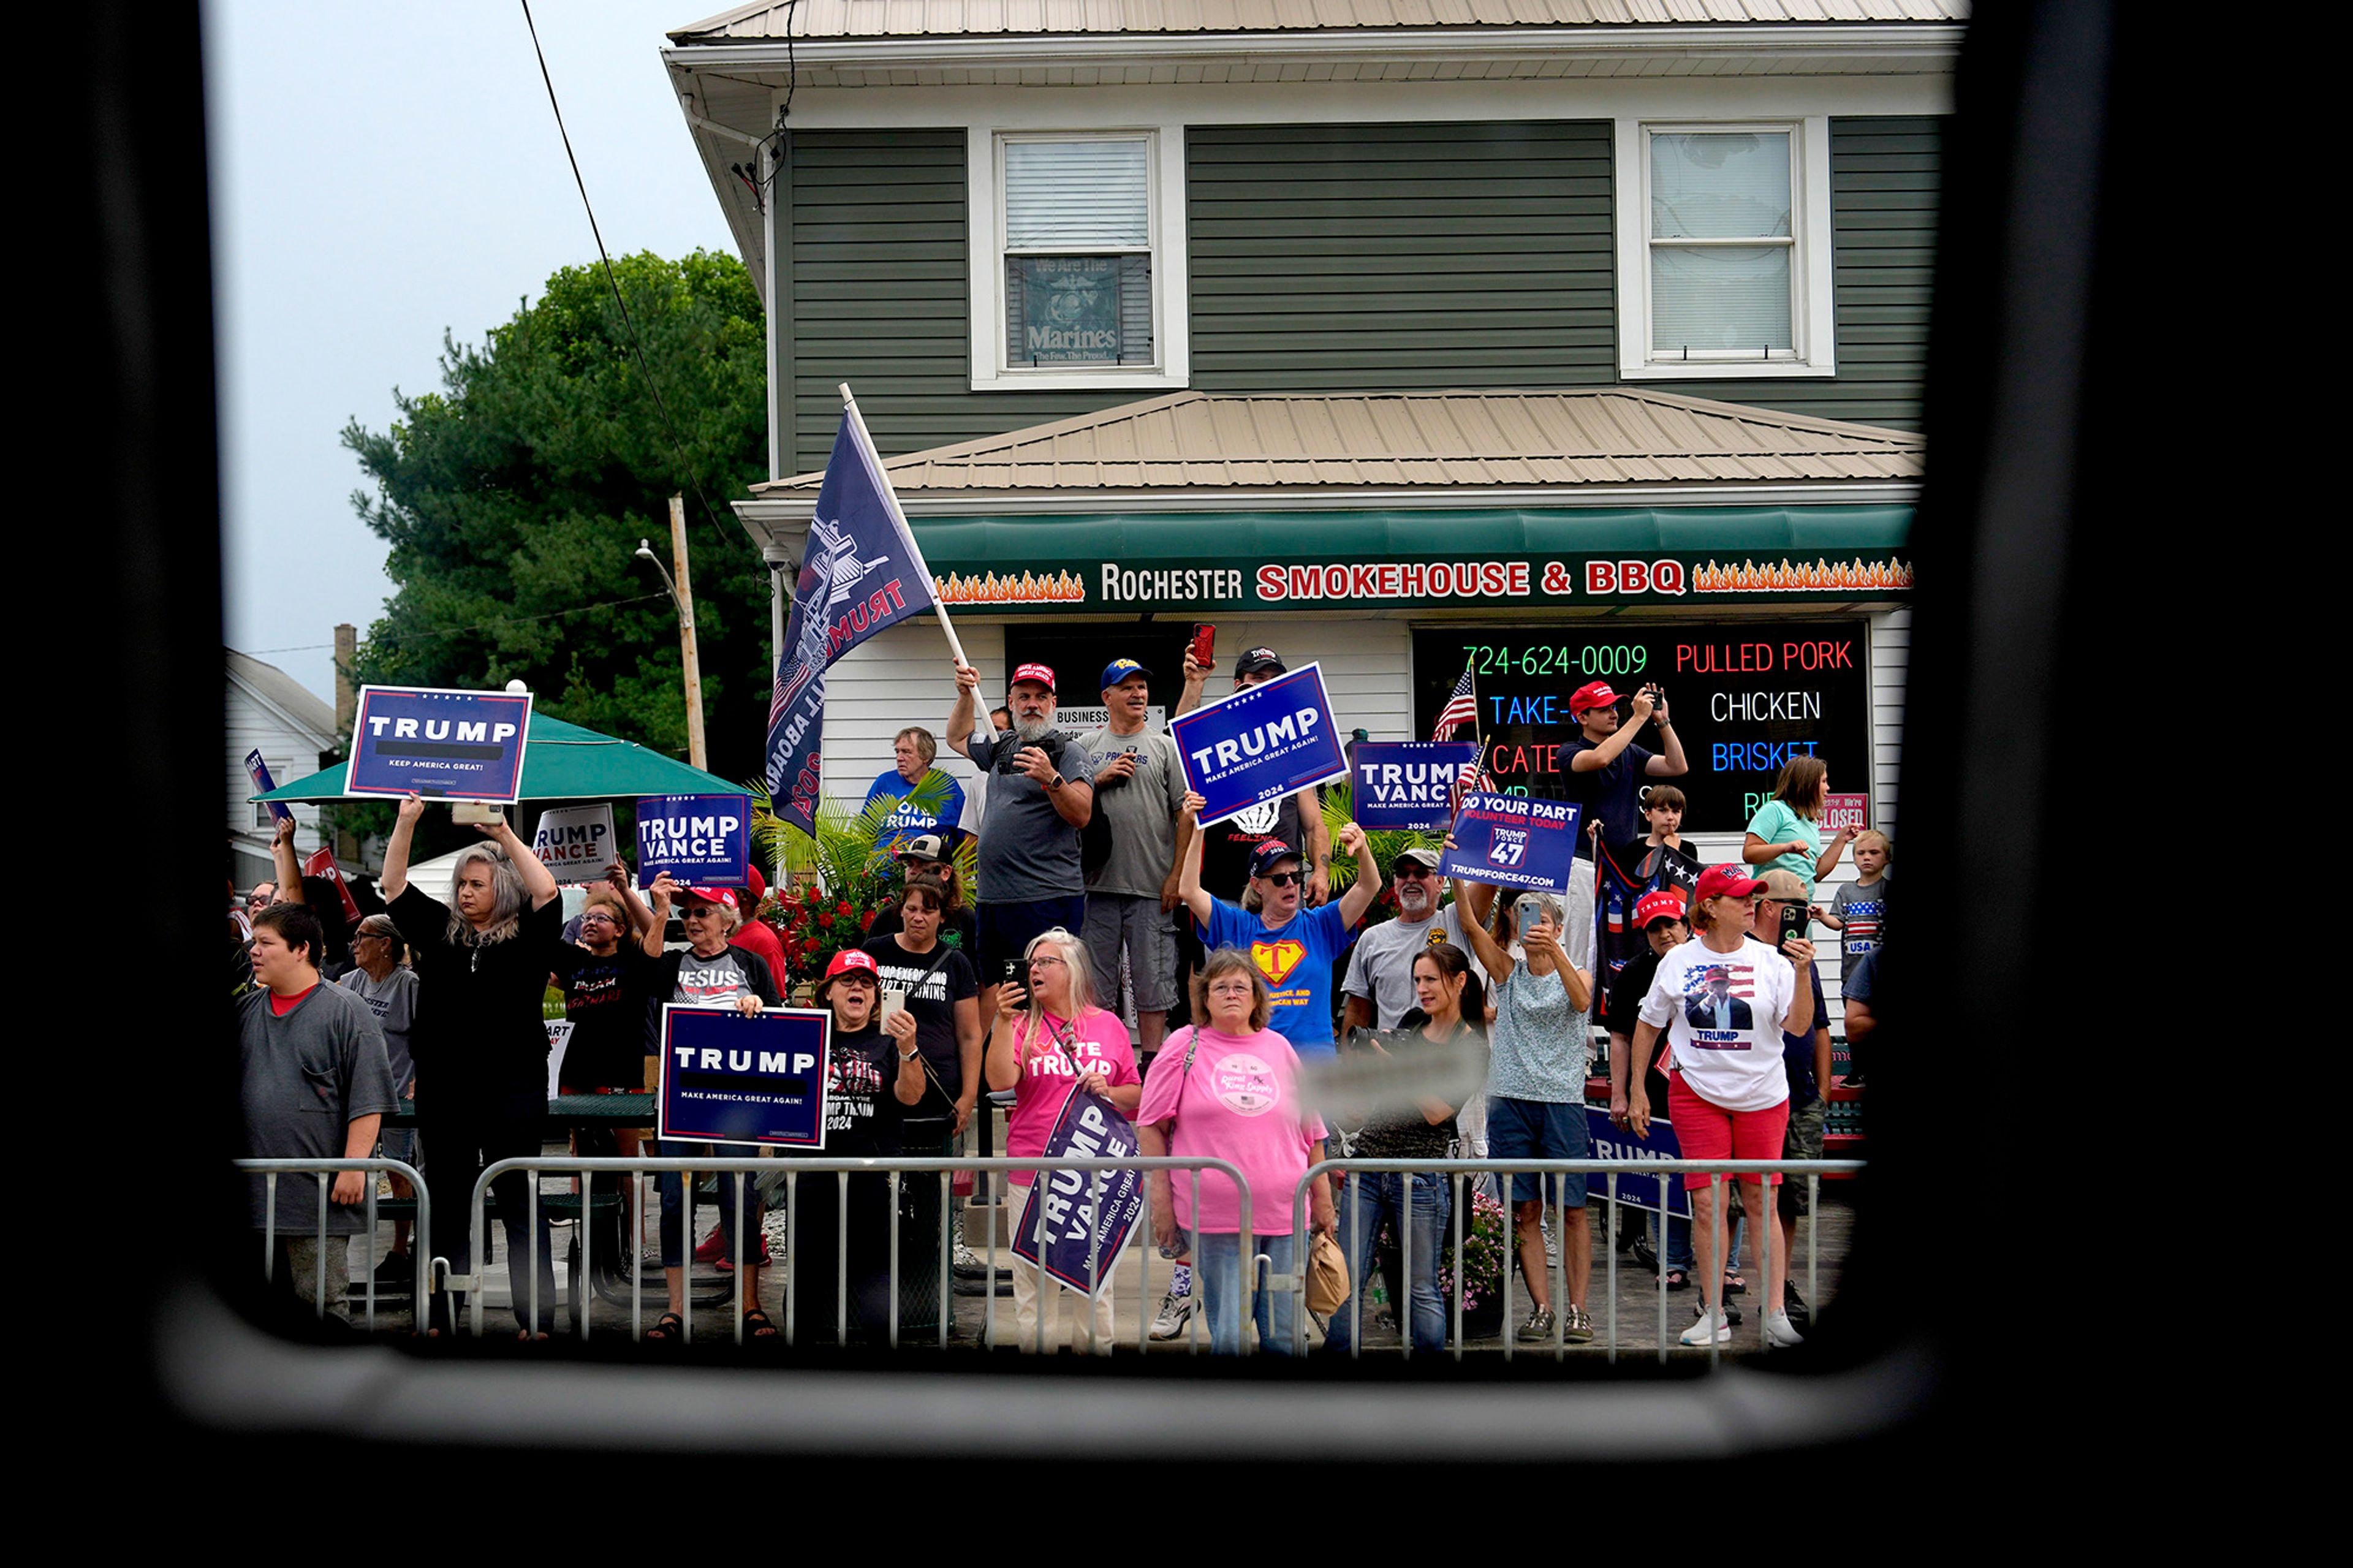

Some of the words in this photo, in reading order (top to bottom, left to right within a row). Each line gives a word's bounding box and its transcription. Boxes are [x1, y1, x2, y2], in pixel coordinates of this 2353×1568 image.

[1058, 259, 1081, 272] Are
[1084, 259, 1107, 272] The
[1028, 325, 1116, 349] Marines
[1101, 563, 1242, 600] ROCHESTER
[1256, 561, 1529, 601] SMOKEHOUSE
[1540, 561, 1571, 594] &
[1585, 559, 1686, 596] BBQ
[1463, 646, 1646, 675] 724-624-0009
[1677, 643, 1773, 672] PULLED
[1784, 641, 1852, 670] PORK
[1058, 711, 1108, 722] BUSINESS
[1490, 696, 1578, 724] TAKE-
[1711, 692, 1820, 722] CHICKEN
[369, 716, 516, 742] TRUMP
[1192, 707, 1318, 775] TRUMP
[412, 761, 450, 770] AMERICA
[1206, 771, 1227, 784] MAKE
[1229, 757, 1262, 776] AMERICA
[1265, 747, 1289, 762] GREAT
[1291, 735, 1318, 751] AGAIN!
[1493, 744, 1561, 774] CATE
[1713, 741, 1819, 771] BRISKET
[1258, 784, 1284, 800] 2024
[1373, 784, 1453, 801] VANC
[1460, 796, 1479, 809] DO
[1483, 797, 1529, 815] YOUR
[1533, 803, 1577, 821] PART
[1464, 809, 1526, 825] VOLUNTEER
[1529, 817, 1566, 830] TODAY
[639, 816, 739, 842] TRUMP
[1494, 828, 1527, 839] TRUMP
[533, 843, 597, 862] VANCE
[646, 838, 725, 858] VANCE
[1490, 842, 1524, 865] 47
[1450, 864, 1555, 887] TRUMPFORCE47.COM
[1641, 900, 1673, 913] TRUMP
[1850, 942, 1871, 952] USA
[1260, 945, 1290, 976] T
[678, 969, 738, 987] JESUS
[896, 967, 947, 985] EXERING
[902, 982, 946, 1001] TRINING
[1697, 1030, 1738, 1041] TRUMP
[675, 1047, 815, 1074] TRUMP
[1029, 1055, 1112, 1077] TRUMP
[706, 1093, 743, 1102] AMERICA
[827, 1115, 852, 1130] 2024
[1588, 1138, 1676, 1160] RUM
[1033, 1105, 1108, 1246] TRUMP
[1123, 1195, 1142, 1223] 2024
[1622, 1193, 1641, 1203] 2024
[1082, 1241, 1101, 1271] MAE
[1097, 1197, 1124, 1243] AMERICA
[1119, 1169, 1137, 1199] GREAT
